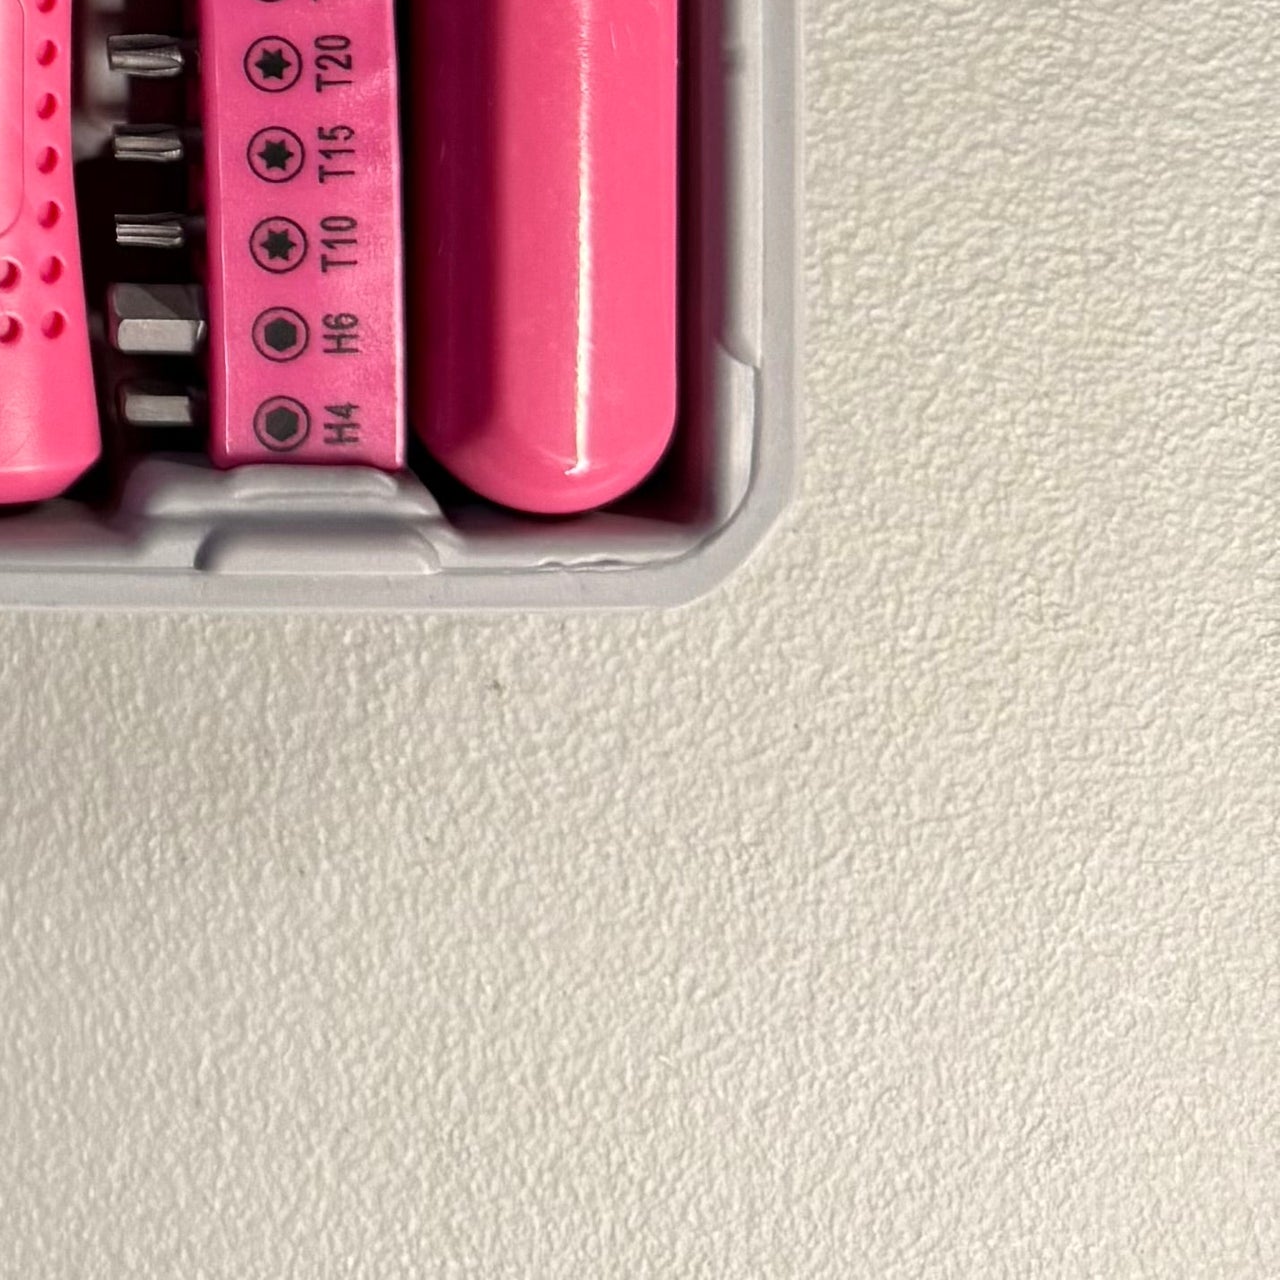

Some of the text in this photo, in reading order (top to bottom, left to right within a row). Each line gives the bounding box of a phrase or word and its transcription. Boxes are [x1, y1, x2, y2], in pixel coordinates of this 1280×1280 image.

[315, 34, 351, 93] T20
[318, 124, 355, 184] T15
[321, 214, 358, 273] T10
[323, 313, 359, 355] H6
[324, 401, 361, 445] H4
